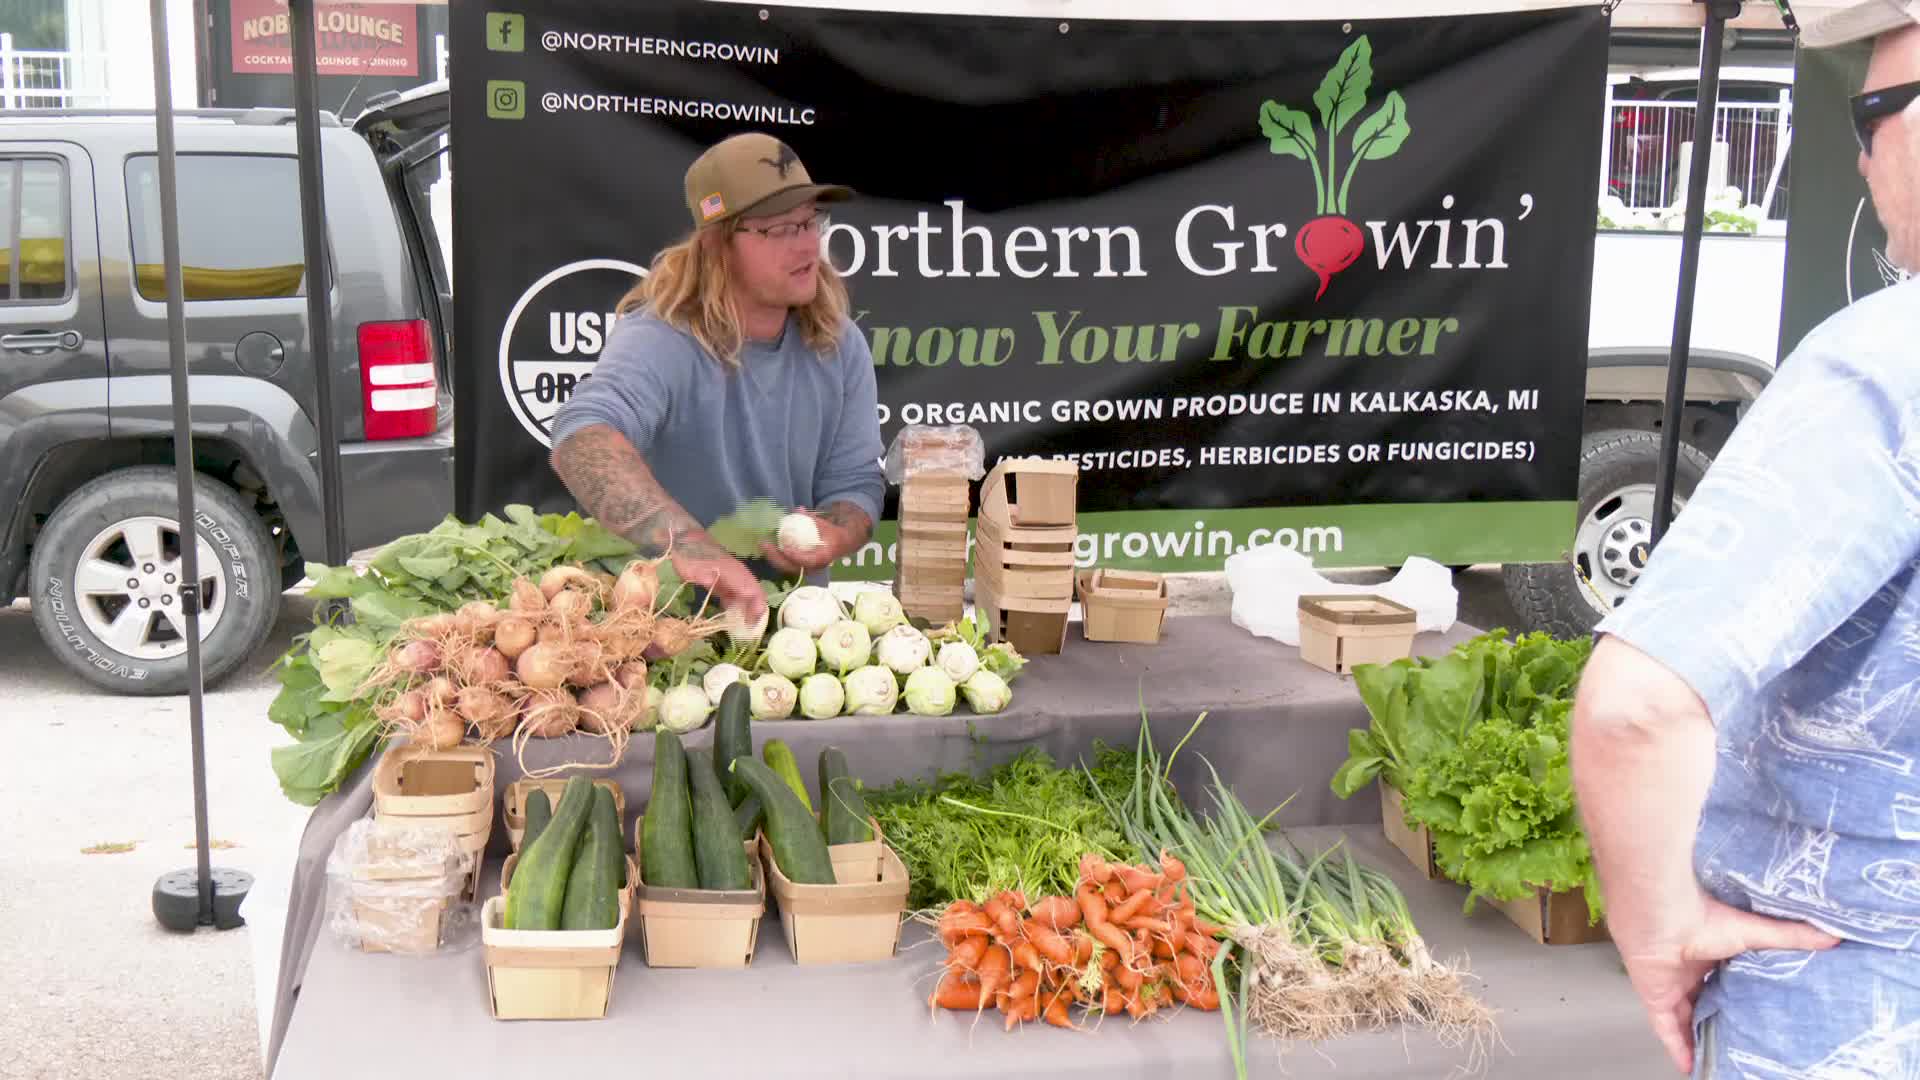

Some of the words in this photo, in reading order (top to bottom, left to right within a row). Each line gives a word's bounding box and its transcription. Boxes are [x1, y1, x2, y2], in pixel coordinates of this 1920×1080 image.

[243, 15, 289, 41] NOB
[318, 11, 403, 44] LOUNGE
[244, 55, 292, 65] COCKTAI
[315, 57, 360, 67] LOUNGE
[541, 30, 779, 65] @NORTHERNGROWIN
[541, 92, 816, 126] @NORTHERNGROWINLLC
[820, 199, 1147, 278] orthern
[856, 310, 1015, 367] now
[1032, 310, 1201, 366] Your
[1209, 306, 1459, 361] Farmer
[901, 401, 1042, 425] ORGANIC
[1051, 399, 1162, 423] GROWN
[1171, 393, 1303, 418] PRODUCE
[1312, 392, 1340, 414] IN
[1350, 390, 1499, 414] KALKASKA,
[1508, 389, 1539, 410] MI
[1200, 444, 1340, 466] HERBICIDES
[1348, 444, 1380, 463] OR
[1387, 440, 1536, 463] FUNGICIDES)
[194, 509, 248, 598] OOPER
[50, 576, 149, 681] EVOLUTION
